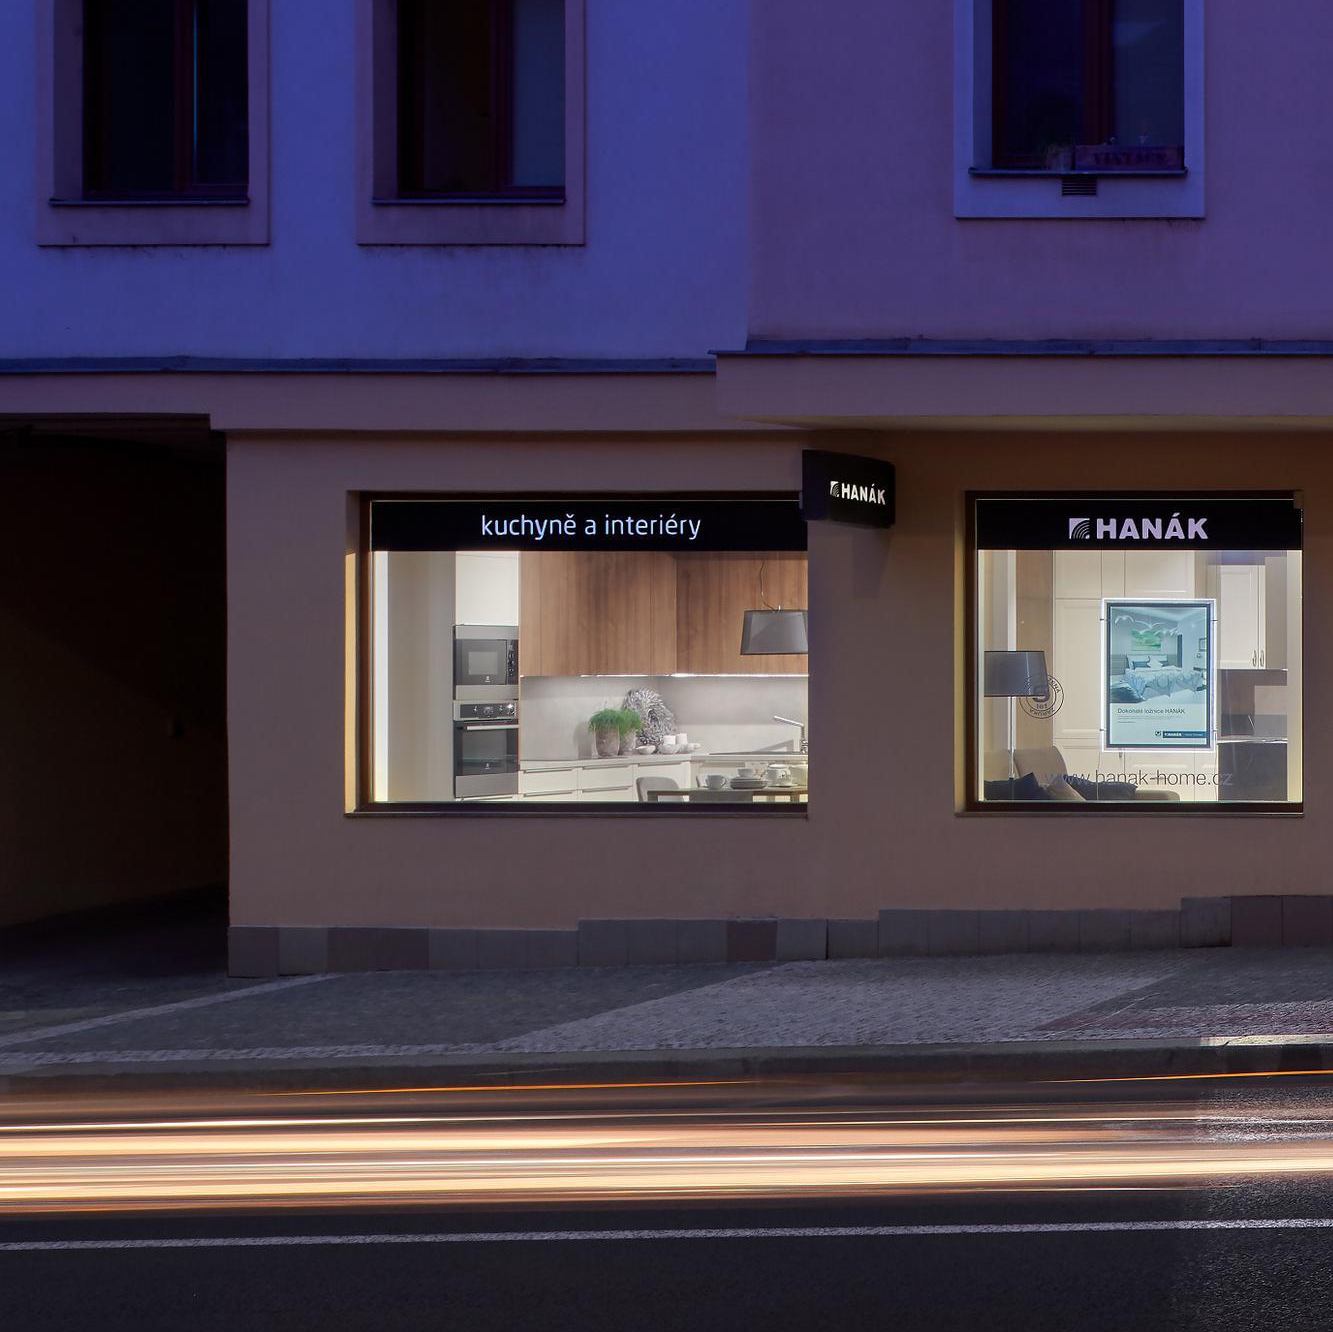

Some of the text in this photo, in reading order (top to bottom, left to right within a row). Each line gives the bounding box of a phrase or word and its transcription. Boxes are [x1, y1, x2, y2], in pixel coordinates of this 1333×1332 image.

[841, 482, 886, 506] HANÁK
[481, 513, 701, 540] kuchyně a interiéry
[1096, 512, 1209, 540] HANÁK
